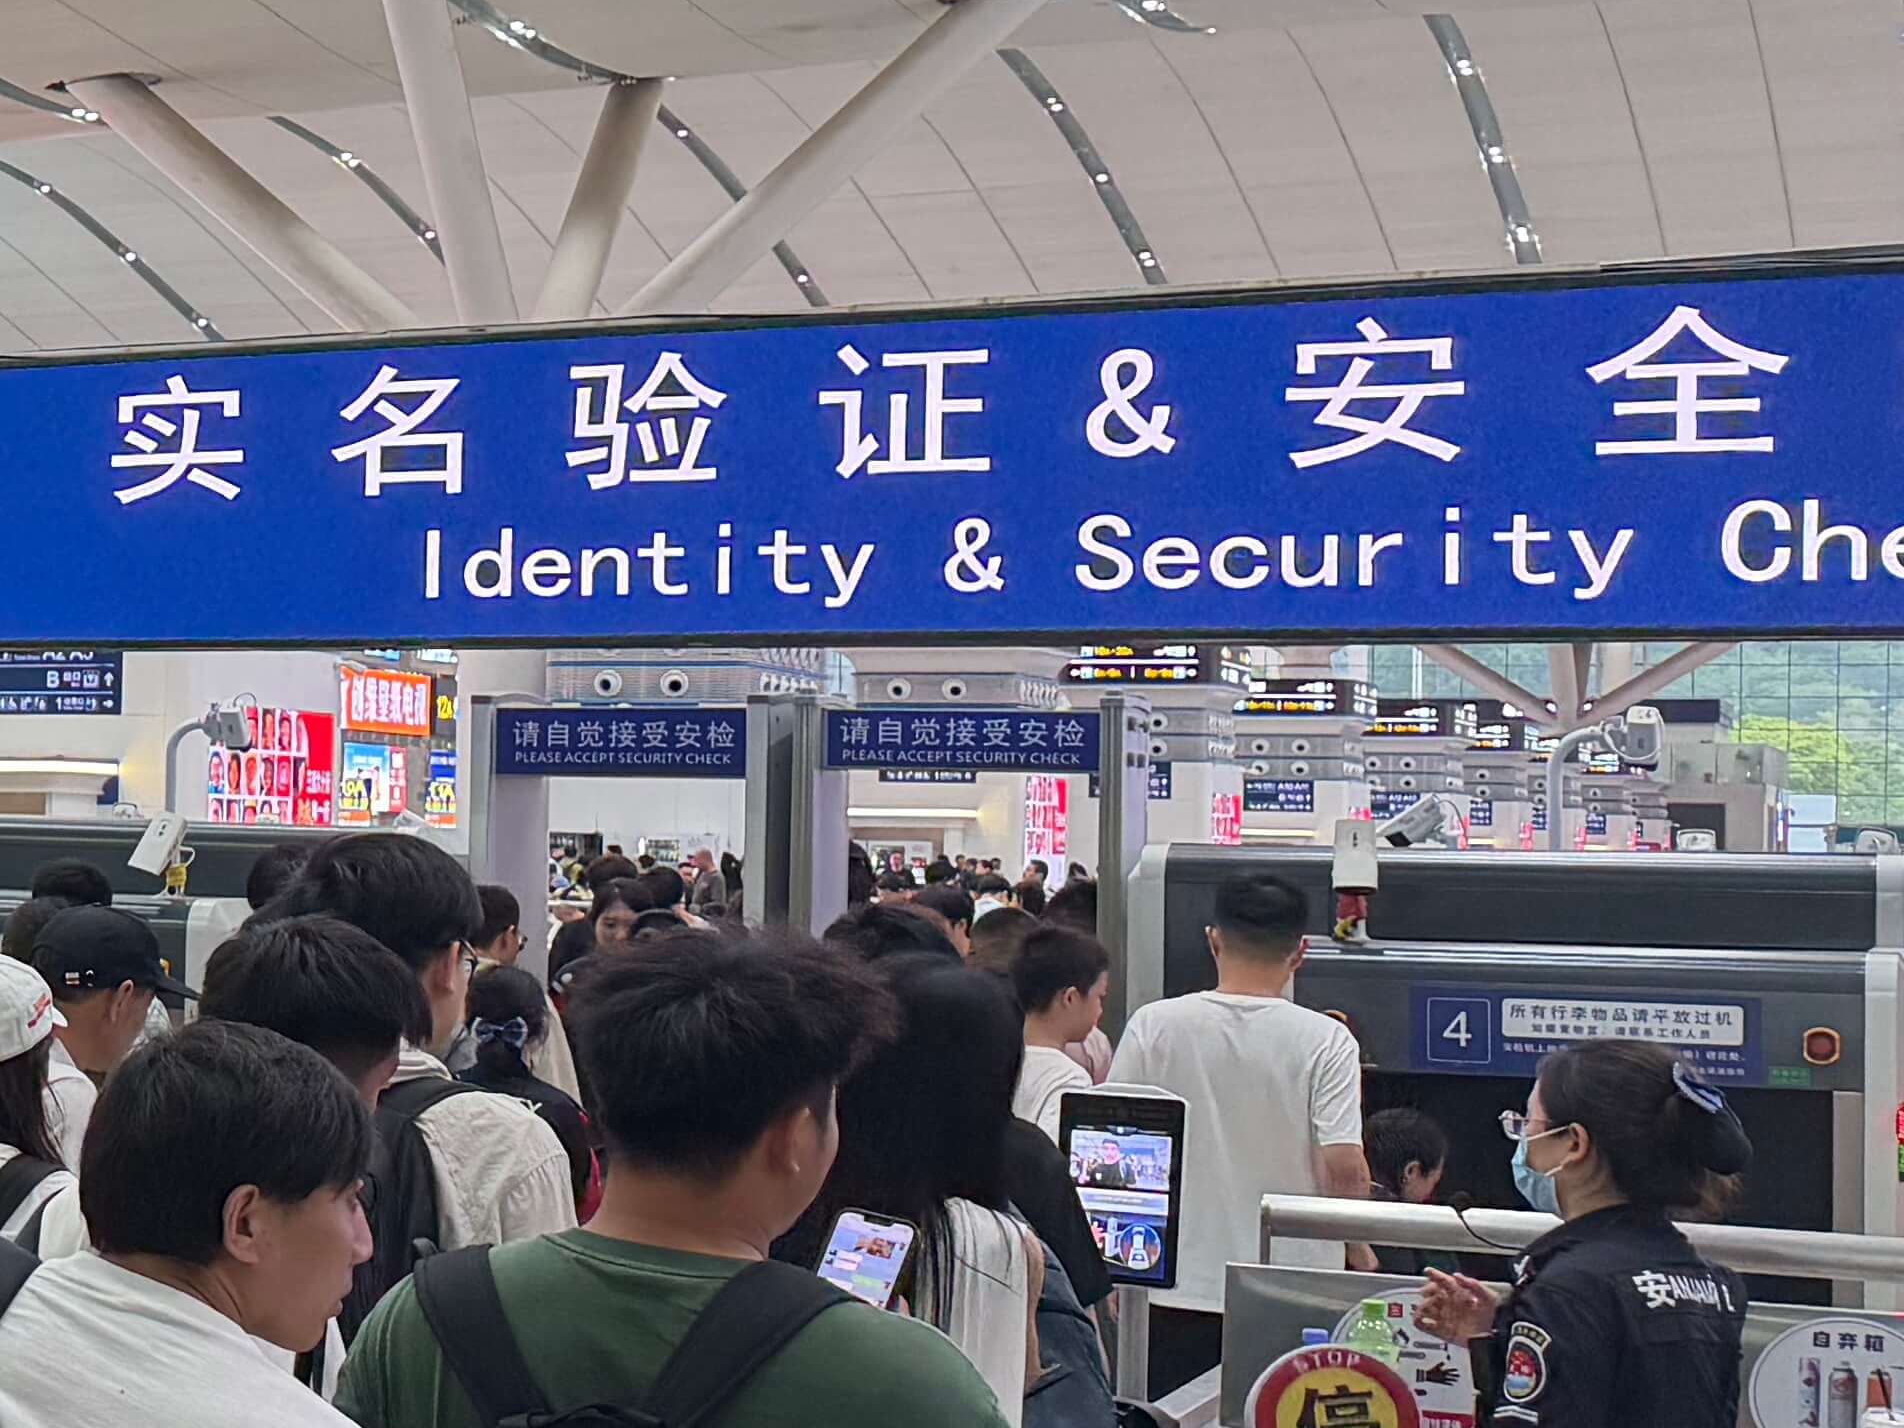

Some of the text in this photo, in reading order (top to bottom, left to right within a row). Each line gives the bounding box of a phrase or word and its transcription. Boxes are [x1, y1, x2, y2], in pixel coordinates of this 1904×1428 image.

[424, 522, 876, 608] Identity
[942, 516, 1007, 593] &
[1074, 505, 1636, 600] Security
[46, 670, 60, 688] B
[512, 720, 735, 748] 请自觉接受安检
[840, 717, 1085, 747] 请自觉接受安检
[515, 751, 732, 765] PLEASE ACCEPT SECURITY CHECK
[842, 749, 1080, 764] PLEASE ACCEPT SECURITY CHECK
[1509, 1003, 1734, 1026] 所有行李物品请平放过机
[1442, 1010, 1473, 1048] 4
